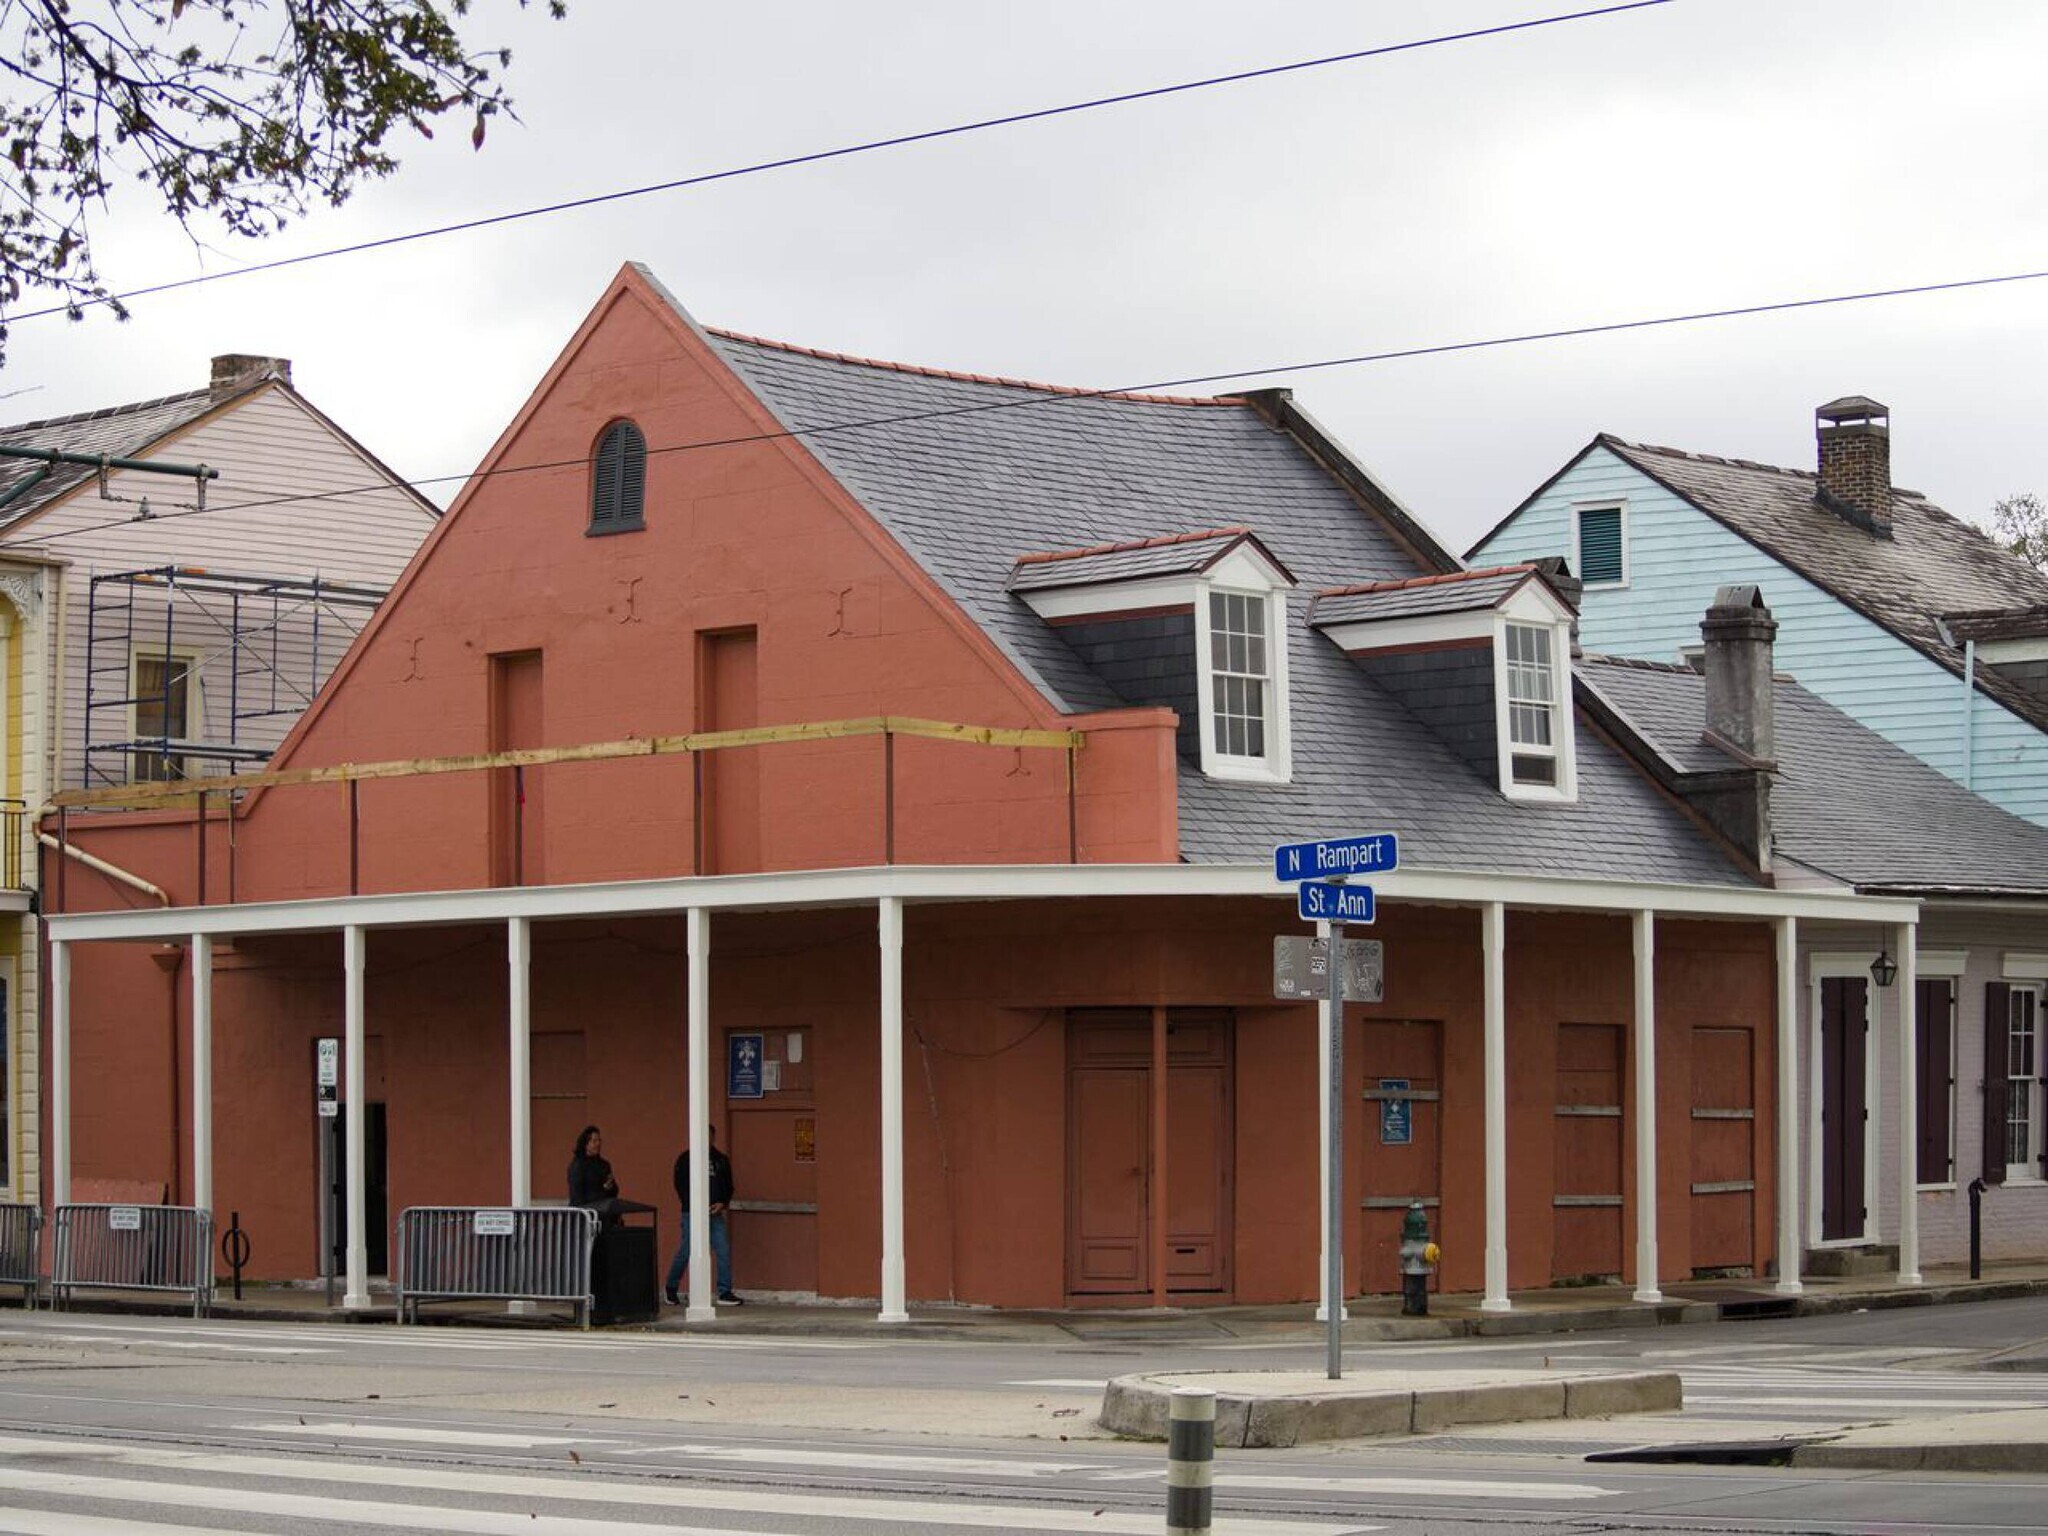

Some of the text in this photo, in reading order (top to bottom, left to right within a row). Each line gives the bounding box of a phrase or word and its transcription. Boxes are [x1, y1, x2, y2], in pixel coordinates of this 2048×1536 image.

[1289, 838, 1382, 872] N Rampart
[1308, 887, 1366, 916] St Ann
